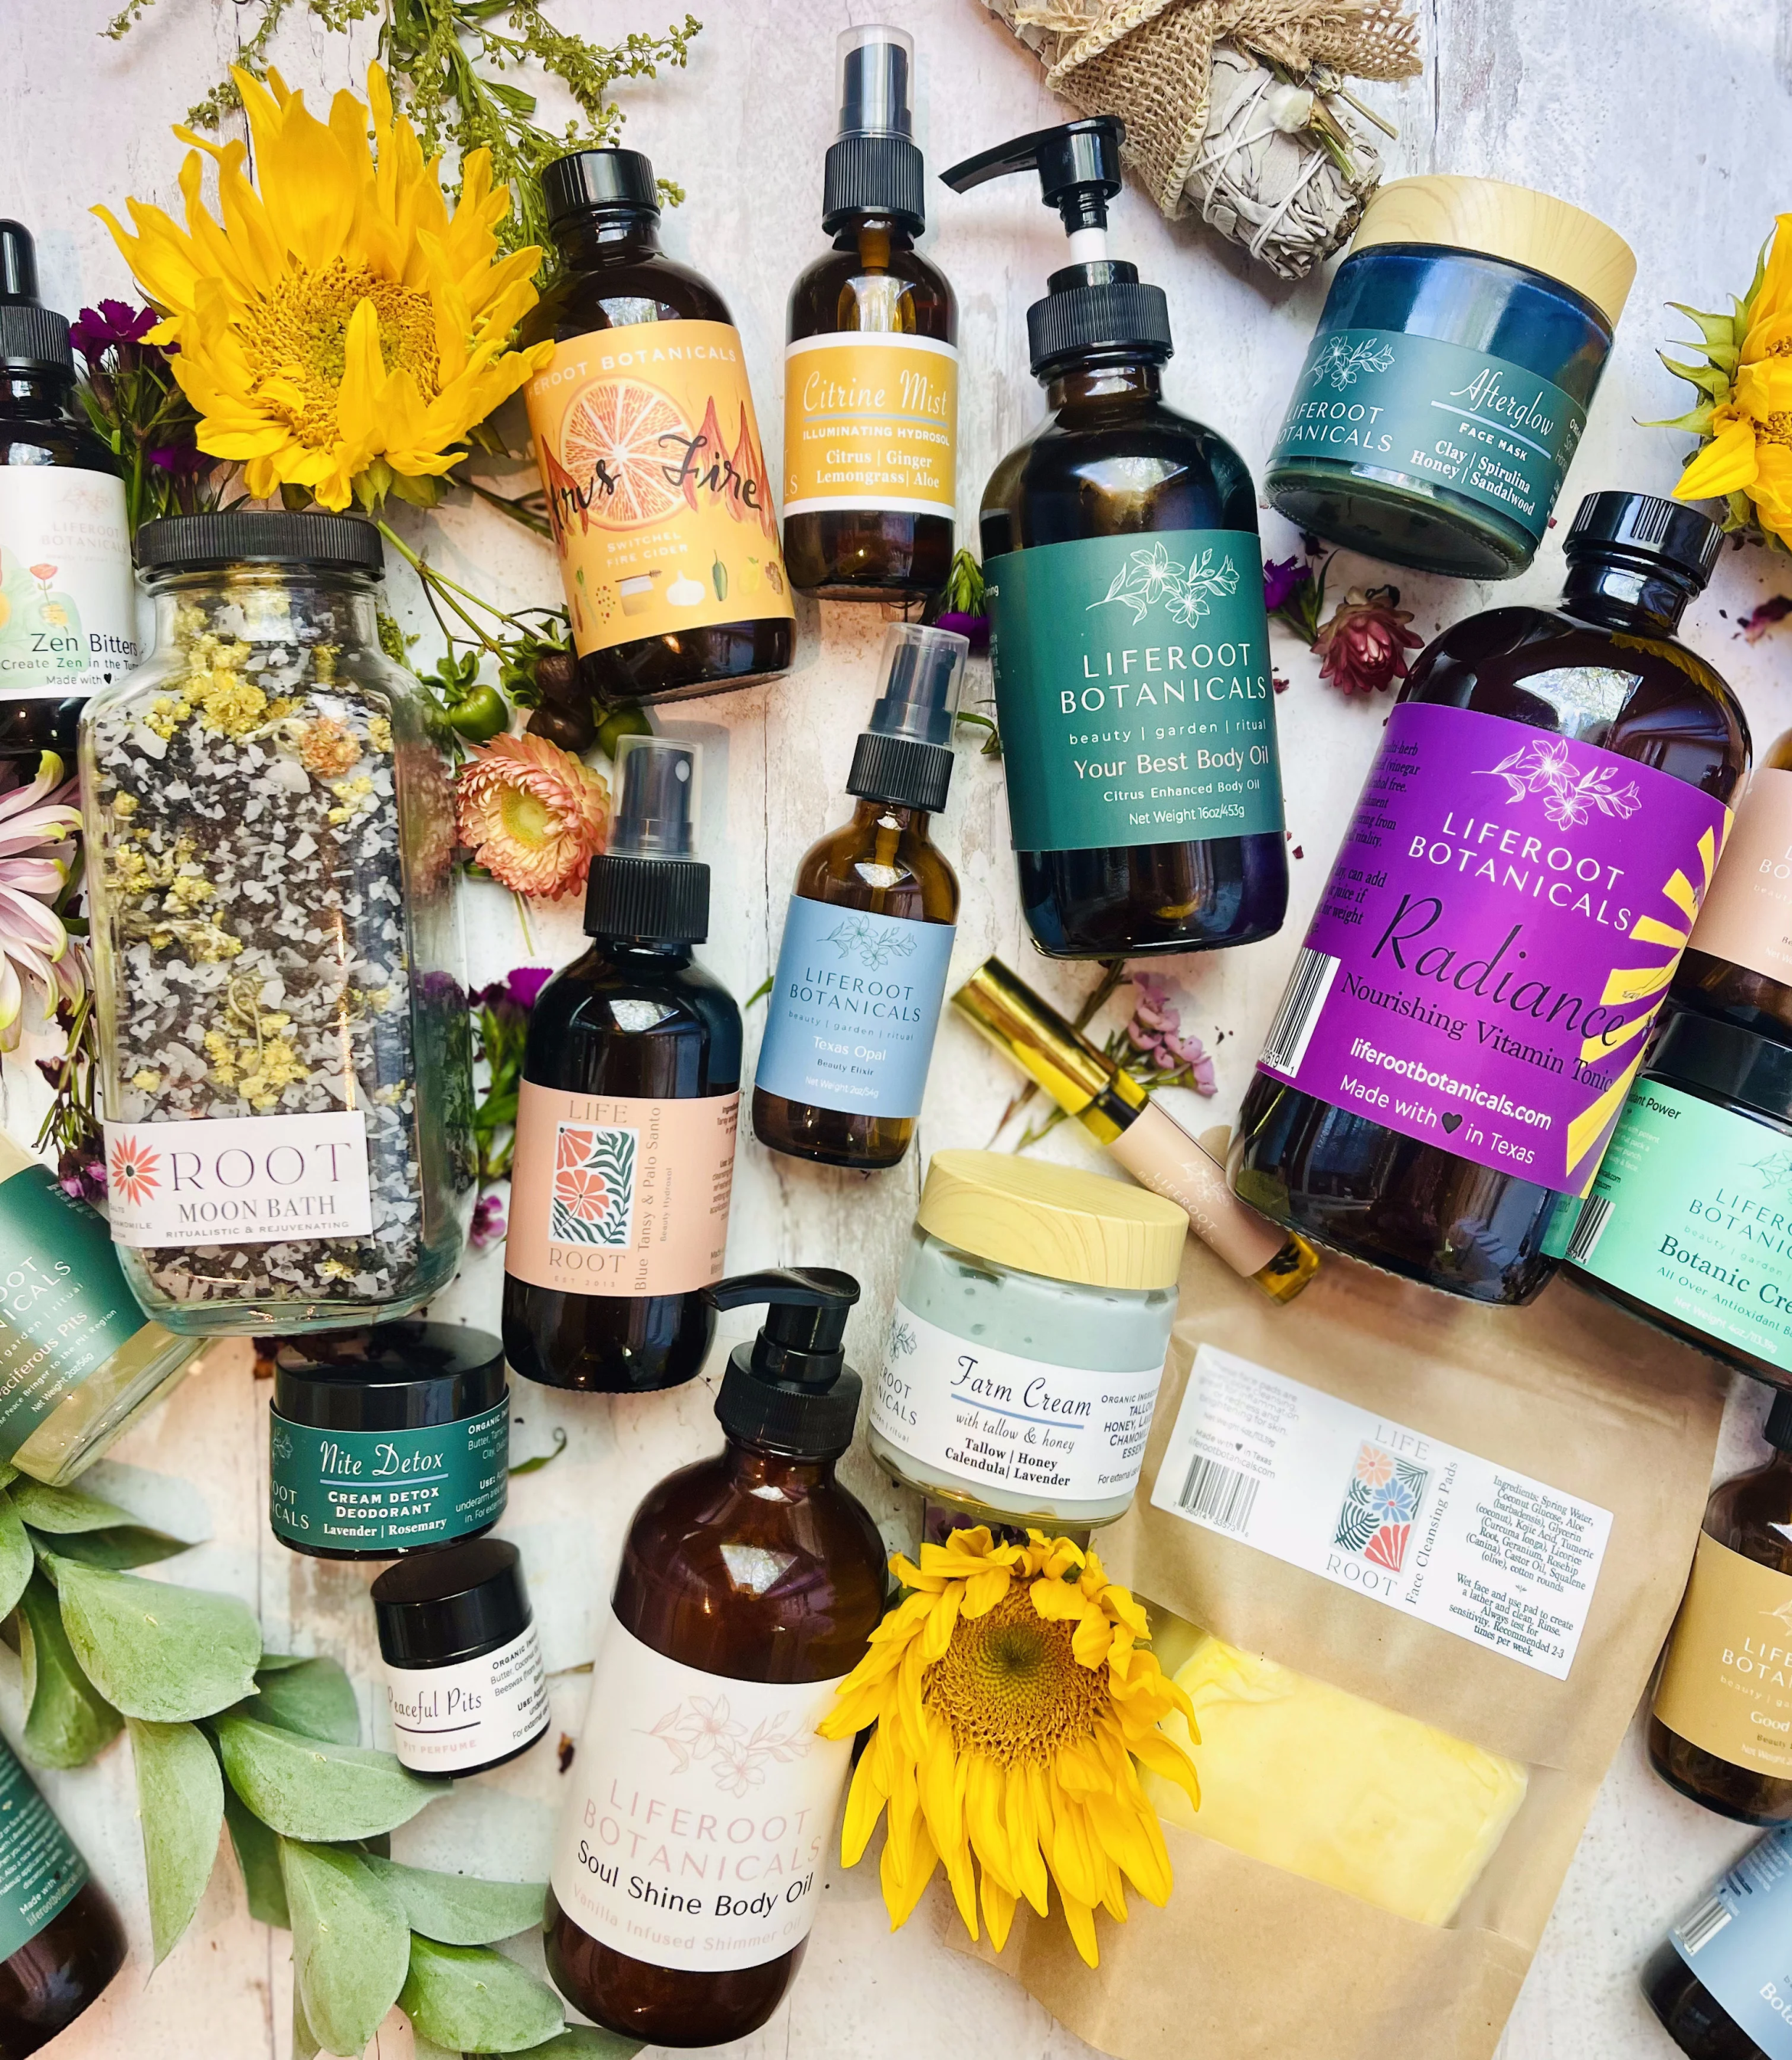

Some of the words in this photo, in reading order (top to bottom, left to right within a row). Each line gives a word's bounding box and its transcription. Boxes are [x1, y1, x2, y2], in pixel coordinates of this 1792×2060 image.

[602, 345, 737, 371] BOTANICALS
[804, 371, 885, 412] Citrine
[901, 370, 947, 416] Mist
[1450, 368, 1555, 436] Afterglow
[1286, 401, 1384, 424] LIFEROOT
[803, 427, 892, 440] ILLUMINATING
[898, 428, 950, 446] HYDROSOL
[1459, 423, 1495, 444] FACE
[1498, 439, 1528, 461] MASK
[659, 434, 762, 511] Fire
[826, 450, 871, 464] Citrus
[887, 450, 932, 469] Ginger
[1435, 440, 1468, 464] Clay
[1478, 456, 1530, 494] Spirulina
[914, 472, 940, 488] Aloe
[1410, 450, 1460, 479] Honey
[1470, 471, 1535, 516] Sandalwood
[607, 531, 682, 553] SWITCHEL
[607, 554, 638, 568] FIRE
[643, 544, 688, 559] CIDER
[31, 633, 78, 652] Zen
[2, 659, 49, 670] Create
[57, 658, 83, 669] Zen
[89, 659, 99, 668] in
[106, 660, 120, 669] the
[1084, 643, 1251, 678] LIFEROOT
[47, 675, 77, 685] Made
[80, 675, 102, 685] with
[1061, 676, 1266, 714] BOTANICALS
[1070, 729, 1131, 745] beauty
[1156, 722, 1218, 740] garden
[1236, 719, 1266, 732] ritual
[1074, 760, 1126, 780] Your
[1138, 752, 1188, 774] Best
[1198, 748, 1244, 771] Body
[1250, 746, 1268, 764] Oil
[1104, 789, 1144, 802] Citrus
[1151, 784, 1212, 798] Enhanced
[1218, 782, 1243, 795] Body
[1247, 780, 1260, 790] Oil
[1130, 813, 1150, 825] Net
[1153, 808, 1196, 823] Weight
[1198, 804, 1244, 821] 16oz/453g
[1442, 811, 1624, 892] LIFEROOT
[1408, 835, 1631, 933] BOTANICALS
[806, 966, 914, 1000] LIFEROOT
[1371, 893, 1626, 1048] Radiance
[790, 984, 921, 1022] BOTANICALS
[789, 1010, 821, 1026] beauty
[834, 1022, 874, 1035] garden
[887, 1032, 914, 1041] ritual
[1341, 972, 1468, 1040] Nourishing
[1476, 1021, 1564, 1074] Vitamin
[1574, 1056, 1612, 1091] Tonic
[813, 1035, 849, 1055] Texas
[855, 1046, 886, 1061] Opal
[818, 1058, 847, 1072] Beauty
[852, 1066, 874, 1075] Elixir
[1350, 1038, 1552, 1130] liferootbotanicals.com
[569, 1100, 627, 1123] LIFE
[1339, 1074, 1390, 1107] Made
[1396, 1098, 1437, 1127] with
[1466, 1123, 1483, 1141] in
[1491, 1131, 1535, 1164] Texas
[1645, 1097, 1682, 1120] Power
[646, 1107, 661, 1149] Santo
[169, 1143, 352, 1191] ROOT
[643, 1156, 657, 1188] Palo
[643, 1195, 653, 1205] &
[662, 1167, 672, 1208] Hydrosol
[1154, 1172, 1217, 1229] LIFEROOT
[178, 1198, 257, 1223] MOON
[267, 1195, 336, 1218] BATH
[659, 1206, 670, 1241] Beauty
[166, 1228, 240, 1238] RITUALISTIC
[260, 1221, 349, 1232] REJUVENATING
[637, 1211, 656, 1253] Tansy
[549, 1247, 626, 1273] ROOT
[634, 1259, 649, 1290] Blue
[1658, 1233, 1751, 1293] Botanic
[1656, 1267, 1674, 1280] All
[1679, 1276, 1709, 1297] Over
[1712, 1293, 1781, 1331] Antioxidant
[57, 1311, 88, 1338] Pits
[950, 1355, 1012, 1403] Farm
[1023, 1377, 1091, 1417] Cream
[956, 1412, 979, 1432] with
[983, 1418, 1019, 1440] tallow
[1024, 1427, 1037, 1444] &
[1042, 1435, 1074, 1453] honey
[1104, 1421, 1136, 1432] HONEY,
[1374, 1424, 1431, 1460] LIFE
[320, 1440, 362, 1476] Nite
[372, 1443, 444, 1476] Detox
[965, 1437, 1006, 1460] Tallow
[1018, 1453, 1058, 1470] Honey
[1014, 1467, 1071, 1486] Lavender
[328, 1491, 381, 1505] CREAM
[390, 1487, 440, 1504] DETOX
[335, 1503, 432, 1519] DEODORANT
[1493, 1475, 1539, 1502] Ingredients:
[1541, 1496, 1568, 1516] Spring
[1570, 1507, 1594, 1526] Water,
[1497, 1489, 1529, 1509] Coconut
[1532, 1503, 1564, 1525] Glucose,
[1566, 1519, 1584, 1532] Aloe
[323, 1523, 377, 1537] Lavender
[388, 1518, 447, 1536] Rosemary
[1405, 1573, 1424, 1605] Face
[1416, 1495, 1448, 1568] Cleansing
[1438, 1461, 1458, 1494] Pads
[1326, 1554, 1398, 1596] ROOT
[388, 1686, 439, 1725] Peaceful
[447, 1688, 482, 1715] Pits
[404, 1741, 416, 1752] PIT
[420, 1740, 476, 1754] PERFUME
[611, 1778, 811, 1843] LIFEROOT
[584, 1798, 820, 1882] BOTANICALS
[577, 1839, 619, 1887] Soul
[628, 1875, 701, 1914] Shine
[715, 1892, 778, 1918] Body
[786, 1872, 813, 1903] Oil
[574, 1883, 617, 1927] Vanilla
[627, 1920, 694, 1950] Infused
[704, 1931, 777, 1952] Shimmer
[783, 1916, 802, 1935] Oil
